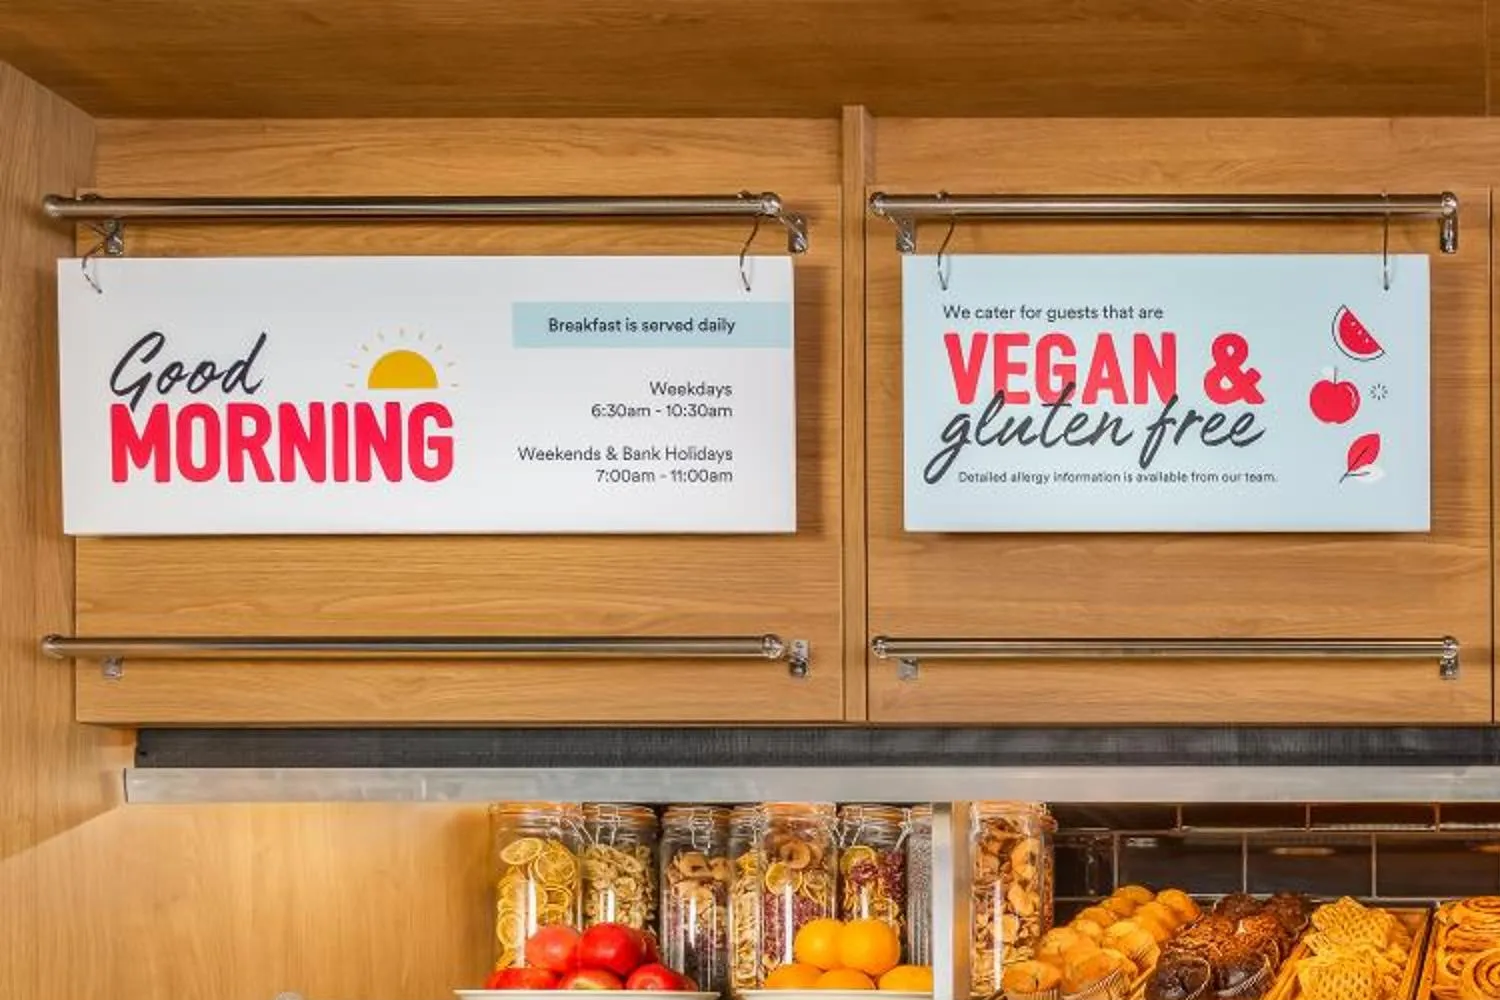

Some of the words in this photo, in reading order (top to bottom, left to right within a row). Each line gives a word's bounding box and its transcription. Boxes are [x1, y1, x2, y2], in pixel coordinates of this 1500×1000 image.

[944, 305, 970, 319] We
[975, 307, 1014, 319] cater
[1020, 305, 1042, 319] for
[1047, 307, 1098, 323] guests
[1103, 305, 1133, 319] that
[1138, 309, 1163, 319] are
[548, 317, 621, 333] Breakfast
[626, 317, 637, 333] is
[642, 317, 693, 333] served
[698, 317, 736, 335] daily
[109, 331, 267, 412] Good
[944, 331, 1177, 405] VEGAN
[1203, 333, 1265, 405] &
[650, 381, 732, 398] Weekdays
[591, 404, 651, 418] 6:30am
[666, 404, 733, 418] 10:30am
[923, 382, 1132, 485] gluten
[1138, 394, 1266, 470] free
[110, 402, 455, 484] MORNING
[518, 447, 600, 461] Weekends
[606, 447, 617, 461] &
[623, 447, 660, 461] Bank
[665, 447, 733, 464] Holidays
[596, 469, 655, 483] 7:00am
[671, 469, 733, 483] 11:00am
[958, 471, 1007, 483] Detailed
[1011, 471, 1050, 485] allergy
[1053, 471, 1121, 483] information
[1123, 472, 1133, 483] is
[1136, 471, 1188, 483] available
[1190, 471, 1219, 483] from
[1222, 473, 1241, 483] our
[1245, 472, 1277, 483] team.
